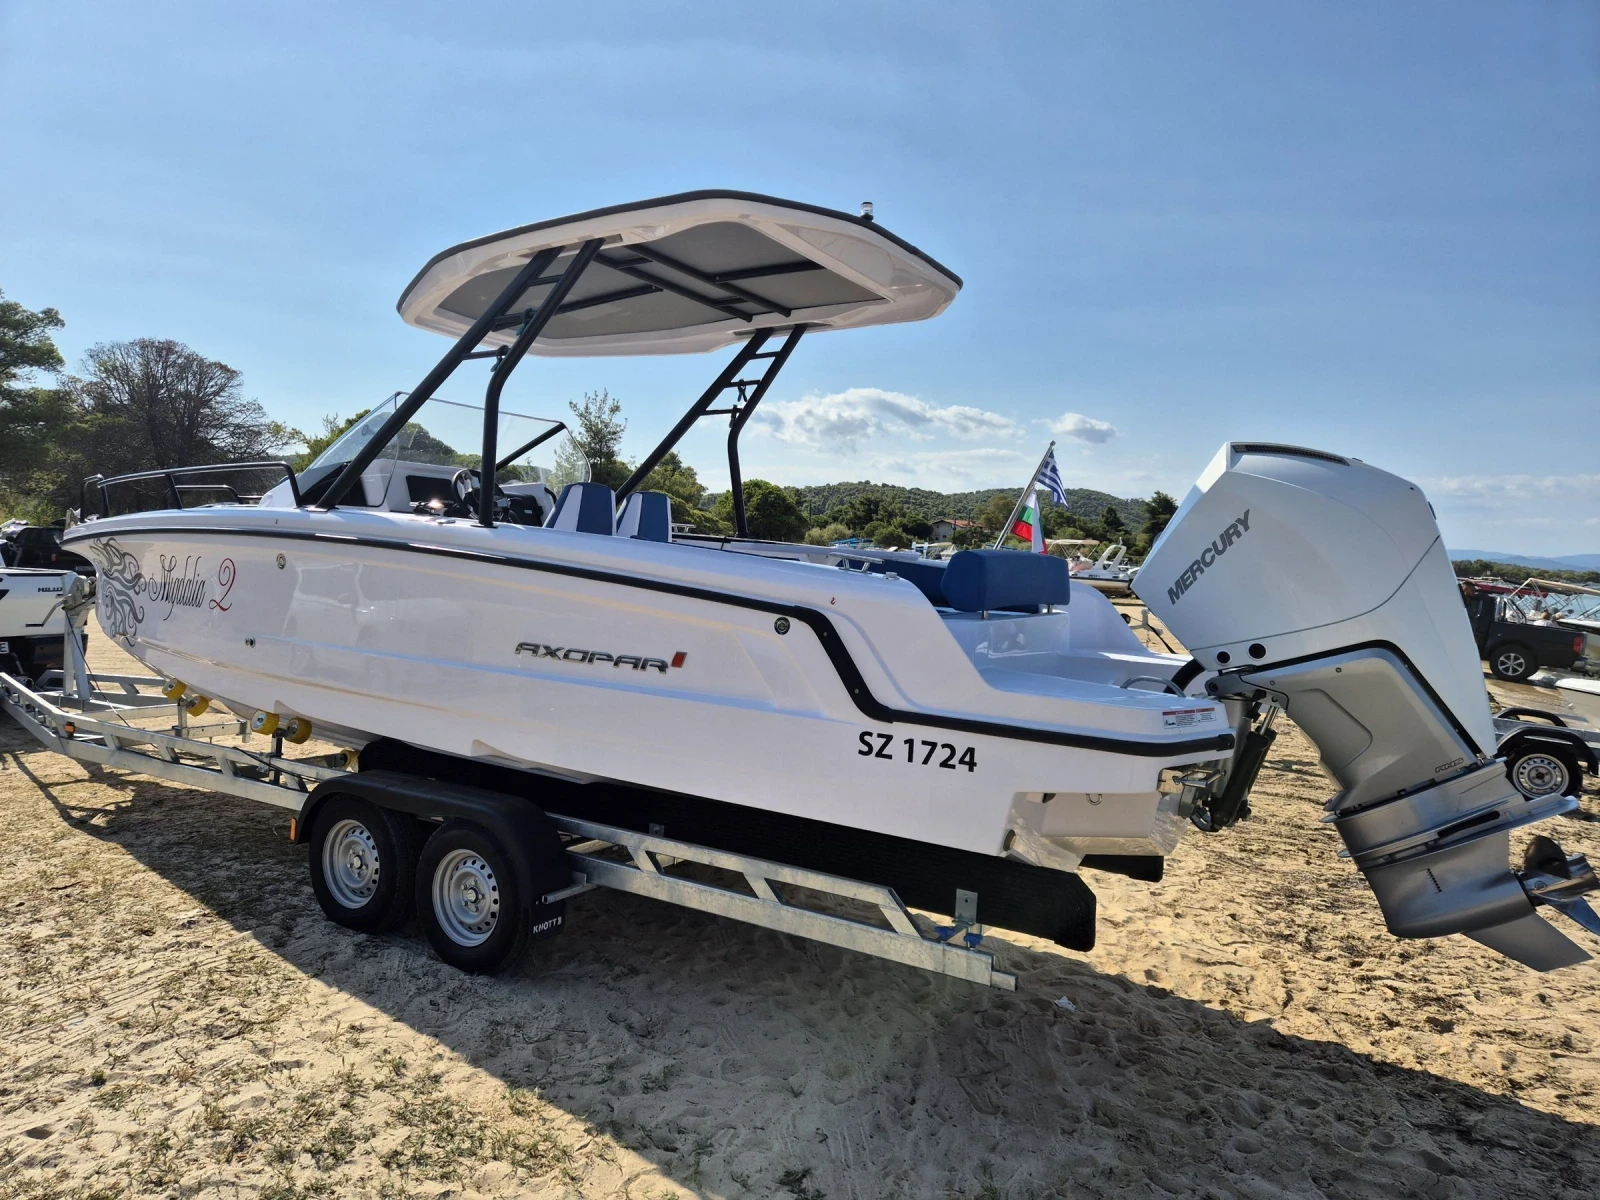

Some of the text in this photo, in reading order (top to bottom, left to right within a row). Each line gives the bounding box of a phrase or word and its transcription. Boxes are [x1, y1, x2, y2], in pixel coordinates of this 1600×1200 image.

[1167, 509, 1250, 605] MERCURY
[209, 558, 236, 611] 2
[514, 641, 669, 674] AXOPAR
[858, 731, 978, 773] SZ 1724
[533, 918, 557, 934] KNOTT
